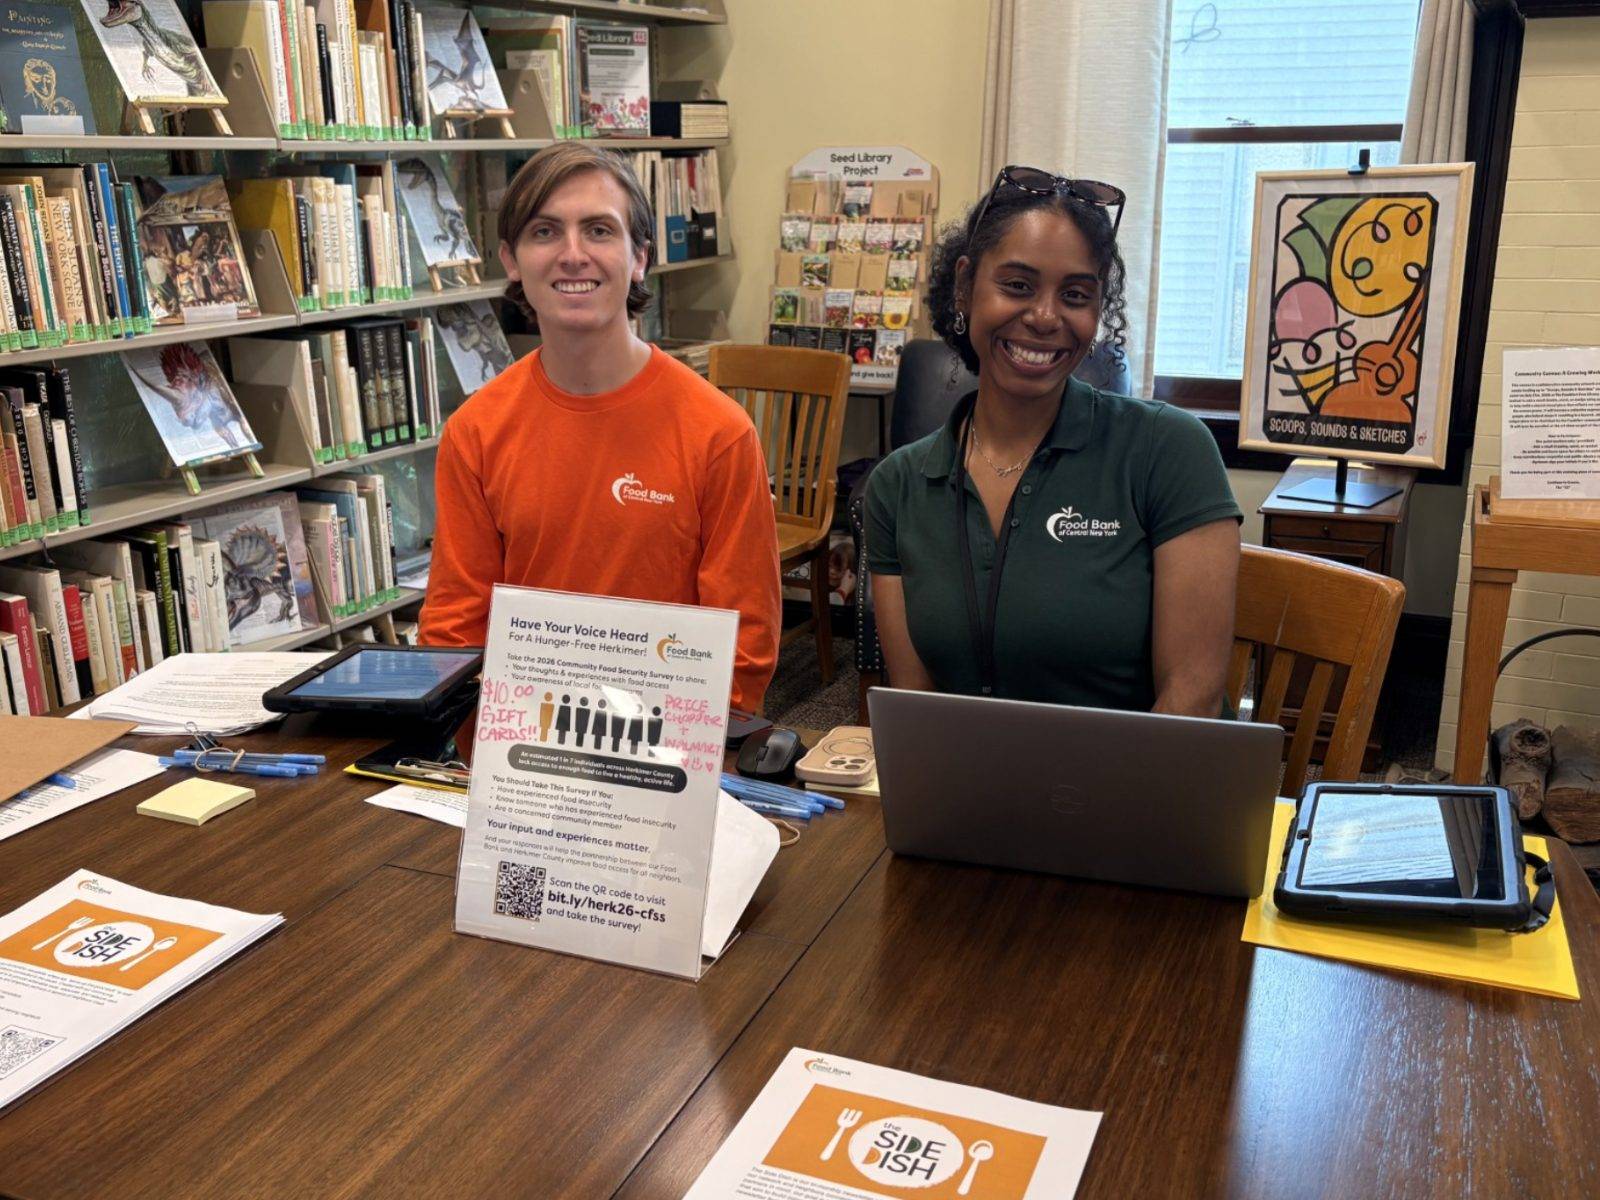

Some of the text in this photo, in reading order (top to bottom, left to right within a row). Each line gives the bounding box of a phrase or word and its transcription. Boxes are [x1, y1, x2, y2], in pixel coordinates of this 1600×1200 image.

[603, 32, 632, 44] Library
[829, 152, 893, 165] Seed Library
[843, 165, 879, 177] Project
[37, 185, 46, 209] JOHN
[41, 211, 50, 239] SLOAN
[299, 205, 307, 237] TITIAN
[110, 225, 118, 245] THE
[53, 204, 76, 308] NEW YORK SCENE
[63, 202, 85, 308] JOHN SLOAN'S
[95, 221, 107, 256] George
[102, 257, 112, 293] Bellows
[861, 371, 874, 380] give
[1269, 417, 1307, 434] SCOOPS,
[1310, 421, 1347, 439] SOUNDS
[1349, 425, 1357, 439] &
[1360, 427, 1407, 445] SKETCHES
[623, 485, 648, 497] Food
[649, 489, 675, 503] Bank
[1059, 519, 1121, 529] Food Bank
[155, 570, 164, 603] BALTHUS
[54, 599, 65, 635] ARMAND
[510, 616, 648, 642] Have Your Voice Heard
[508, 631, 647, 656] For A Hunger-Free Herkimer!
[666, 645, 712, 659] Food Bank
[507, 652, 522, 661] Take
[523, 655, 535, 663] the
[536, 656, 555, 665] 2026
[556, 658, 597, 671] Community
[598, 664, 617, 672] Food
[617, 666, 648, 678] Security
[648, 670, 674, 681] Survey
[685, 675, 706, 684] share:
[511, 672, 526, 680] Your
[526, 676, 563, 685] awareness
[572, 680, 590, 688] local
[512, 662, 527, 671] Your
[528, 665, 559, 675] thoughts
[567, 671, 609, 682] experiences
[627, 677, 644, 686] food
[644, 681, 669, 689] access
[483, 676, 534, 705] $10.00
[481, 704, 527, 726] GIFT
[664, 694, 709, 713] PRICE
[664, 711, 723, 728] CHOPPER
[477, 724, 539, 744] CARDS!!
[491, 774, 505, 782] You
[505, 776, 530, 786] Should
[531, 780, 548, 789] Take
[549, 782, 564, 791] This
[565, 785, 590, 797] Survey
[597, 790, 613, 799] You:
[496, 785, 612, 810] Have experienced food insecurity
[494, 803, 506, 812] Are
[513, 808, 551, 819] concerned
[551, 814, 591, 826] community
[592, 820, 622, 830] member
[495, 794, 676, 830] Know someone who has experienced food insecurity
[486, 818, 650, 853] Your input and experiences matter.
[549, 876, 665, 906] Scan the QR code to visit
[547, 889, 665, 922] bit.ly/herk26-cfss
[546, 907, 641, 933] and take the survey!
[61, 940, 122, 963] DISH
[85, 929, 142, 951] SIDE
[883, 1121, 902, 1131] the
[872, 1130, 947, 1162] SIDE
[862, 1146, 938, 1181] DISH
